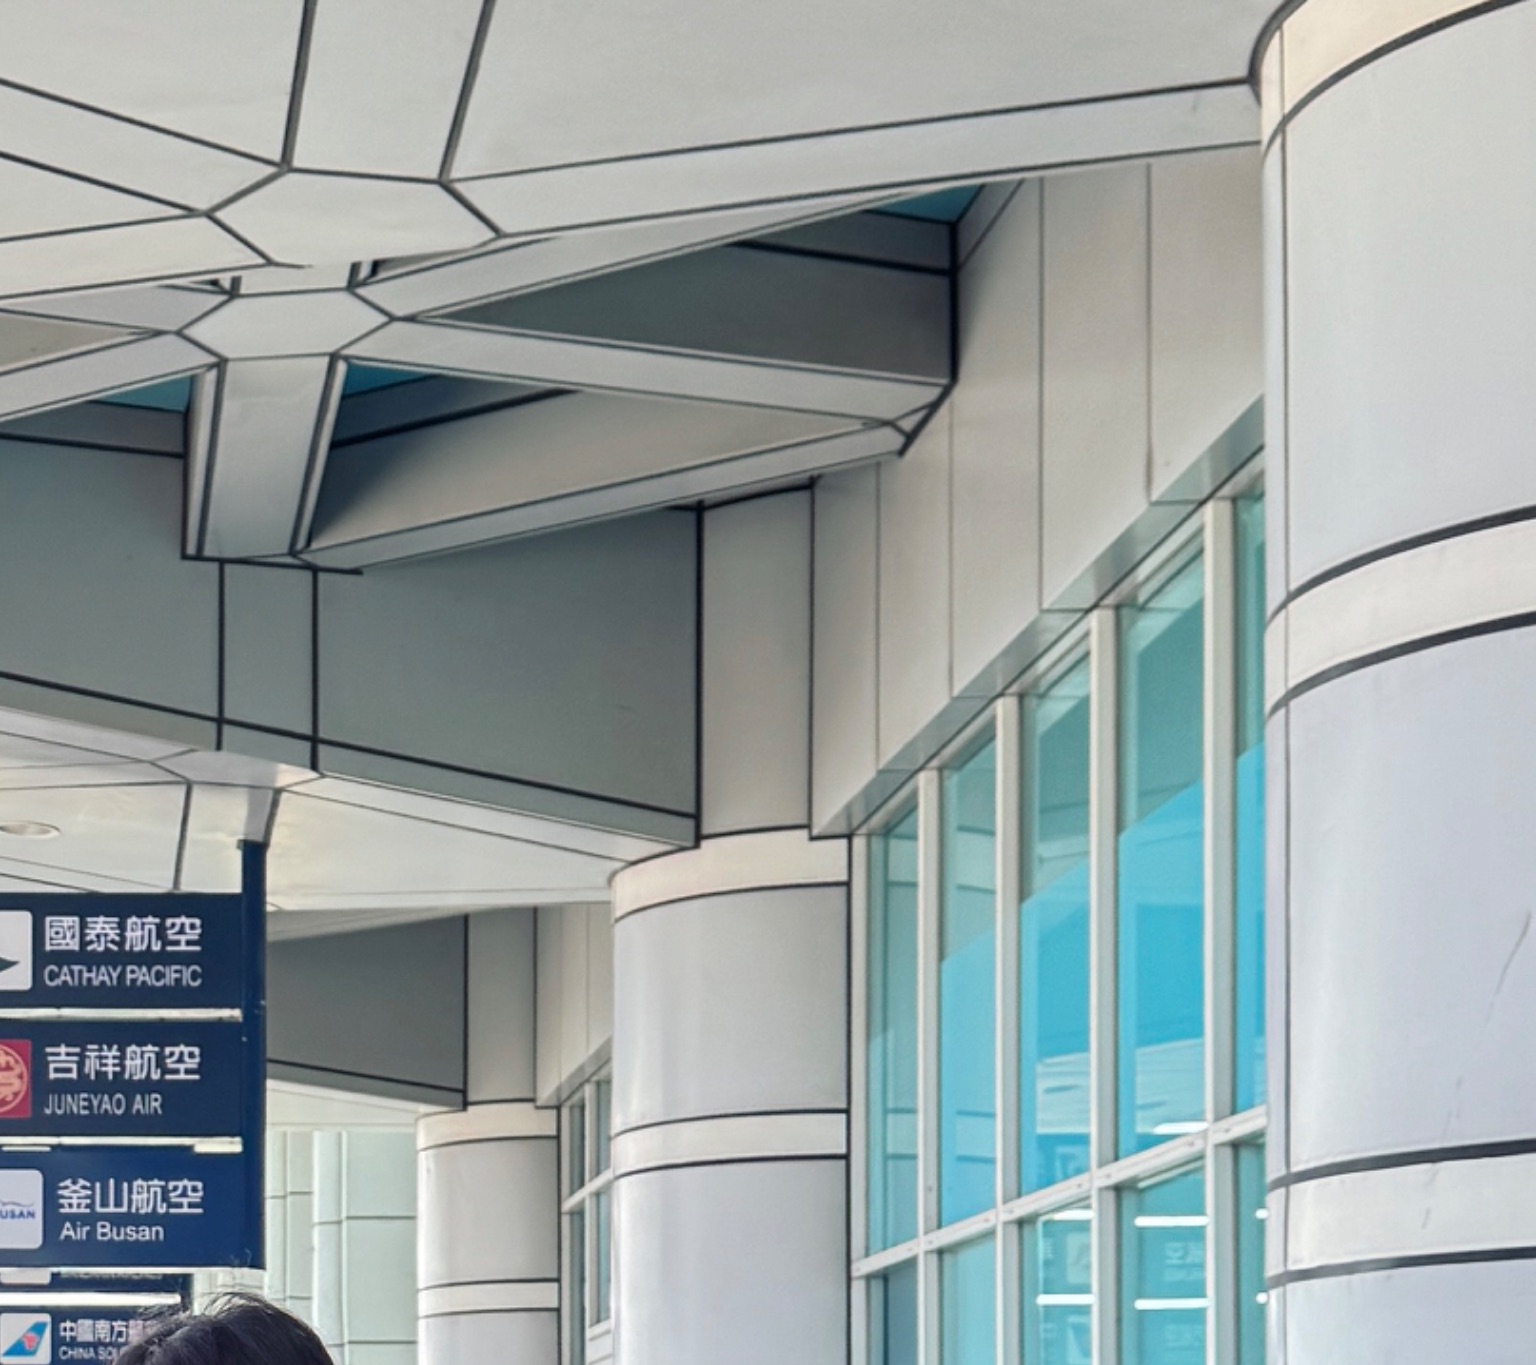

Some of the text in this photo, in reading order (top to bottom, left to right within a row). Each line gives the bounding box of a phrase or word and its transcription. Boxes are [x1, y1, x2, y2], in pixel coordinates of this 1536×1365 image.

[44, 915, 202, 952] 國泰航空
[43, 964, 202, 987] CATHAY PACIFIC
[44, 1043, 201, 1081] 吉祥航空
[44, 1093, 163, 1116] JUNEYAO AIR
[57, 1177, 204, 1214] 釜山航空
[60, 1221, 164, 1241] Air Busan
[59, 1346, 96, 1360] CHINA
